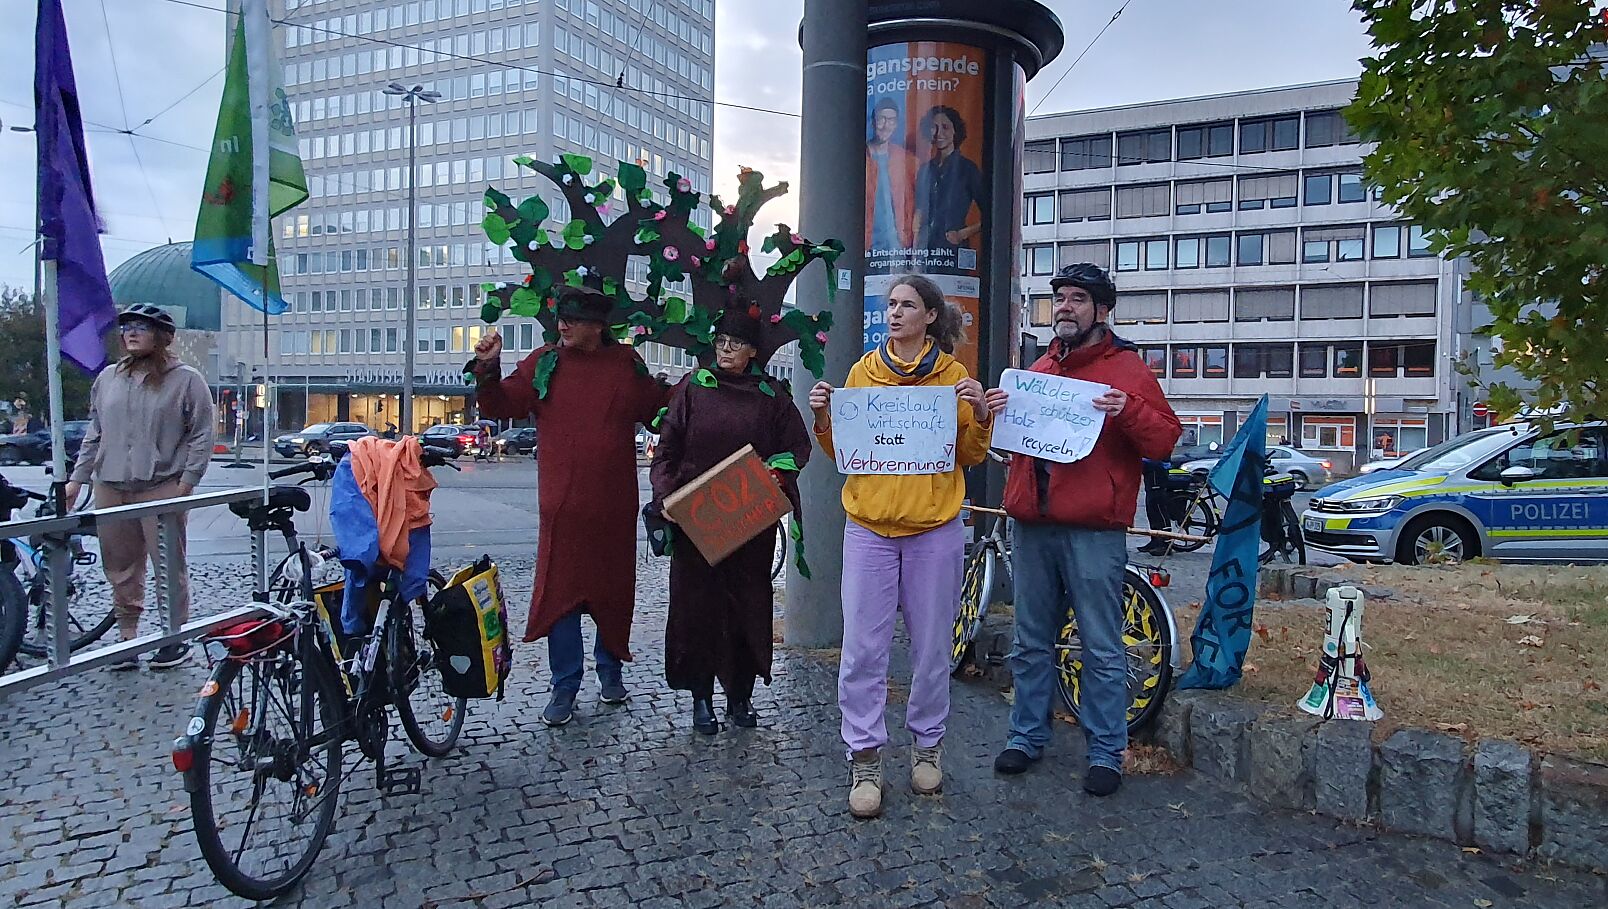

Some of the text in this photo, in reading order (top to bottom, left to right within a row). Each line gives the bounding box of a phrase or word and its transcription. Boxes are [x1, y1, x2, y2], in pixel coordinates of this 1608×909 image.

[867, 55, 979, 81] ganspende
[877, 78, 913, 94] oder
[916, 77, 960, 92] nein?
[872, 247, 928, 259] Entscheidung
[869, 258, 955, 269] organspende-info.de
[1016, 375, 1081, 402] Wälder
[867, 393, 941, 413] Kreislauf
[867, 414, 945, 435] wirtschaft
[1003, 407, 1035, 428] Holz
[874, 433, 906, 445] statt
[1510, 502, 1590, 521] POLIZEI
[1209, 557, 1254, 638] FOR
